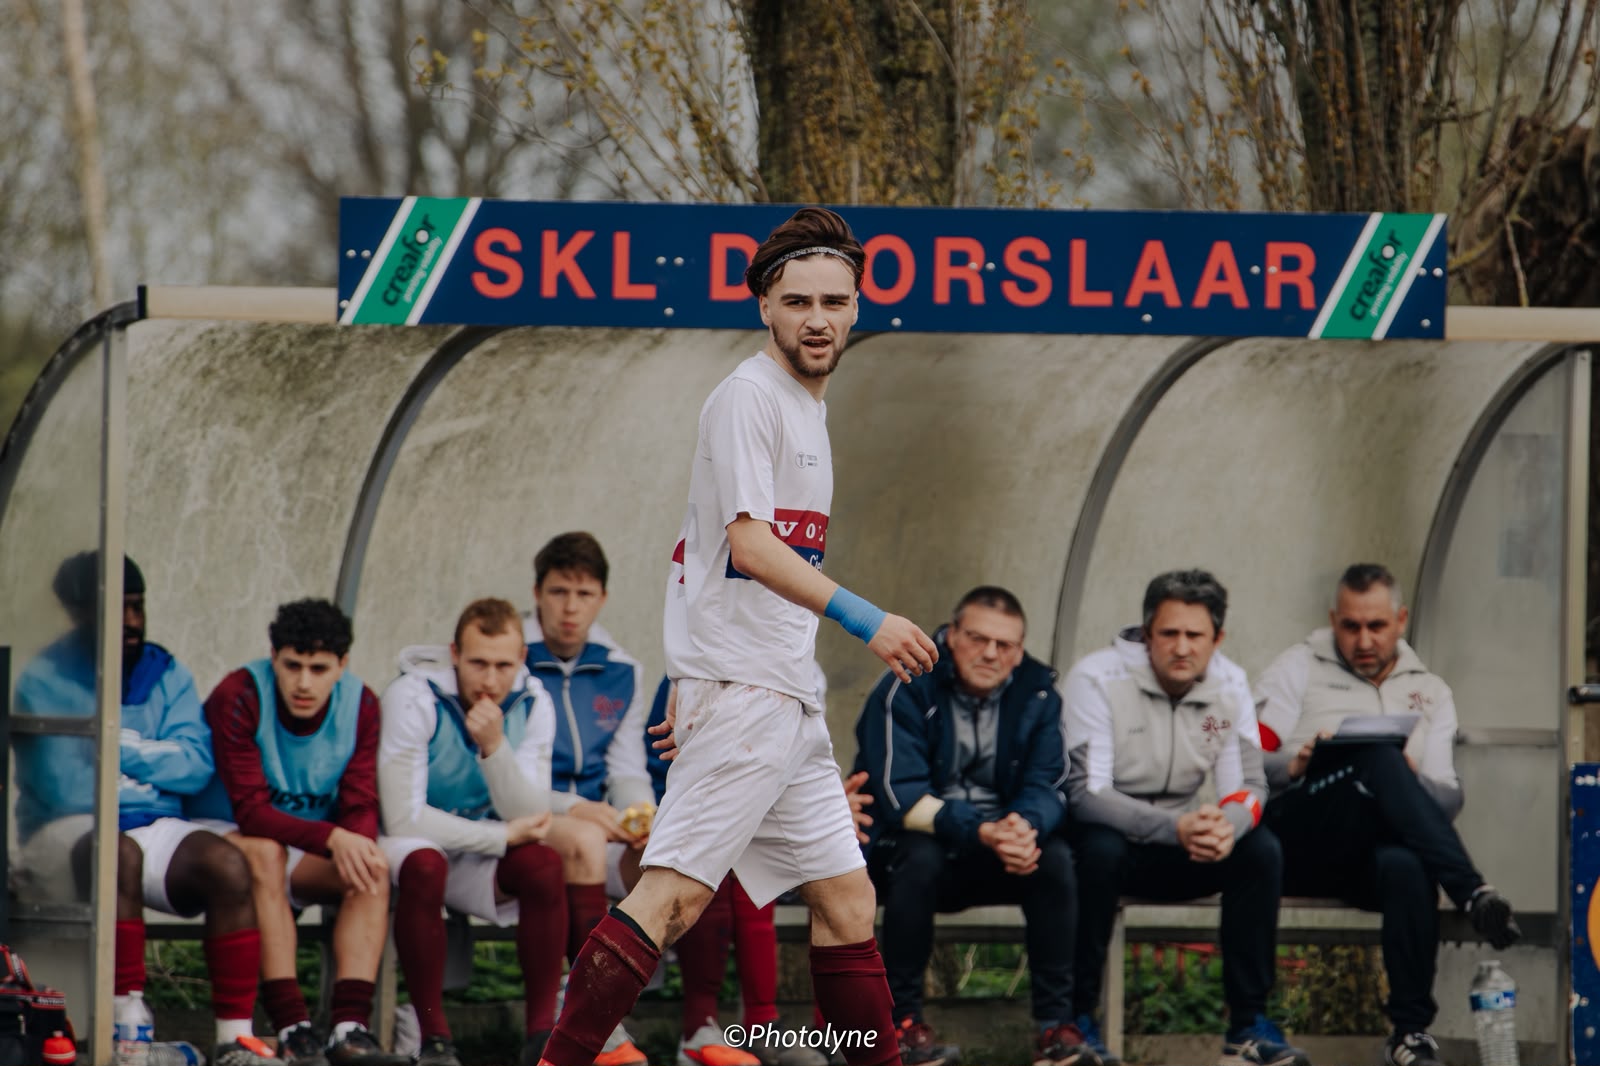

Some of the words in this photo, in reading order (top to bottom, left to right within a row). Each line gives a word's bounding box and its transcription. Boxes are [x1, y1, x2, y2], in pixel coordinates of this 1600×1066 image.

[382, 213, 436, 306] creafor
[471, 226, 658, 301] SKL
[709, 232, 1318, 310] DORSLAAR
[1351, 229, 1402, 320] creafor
